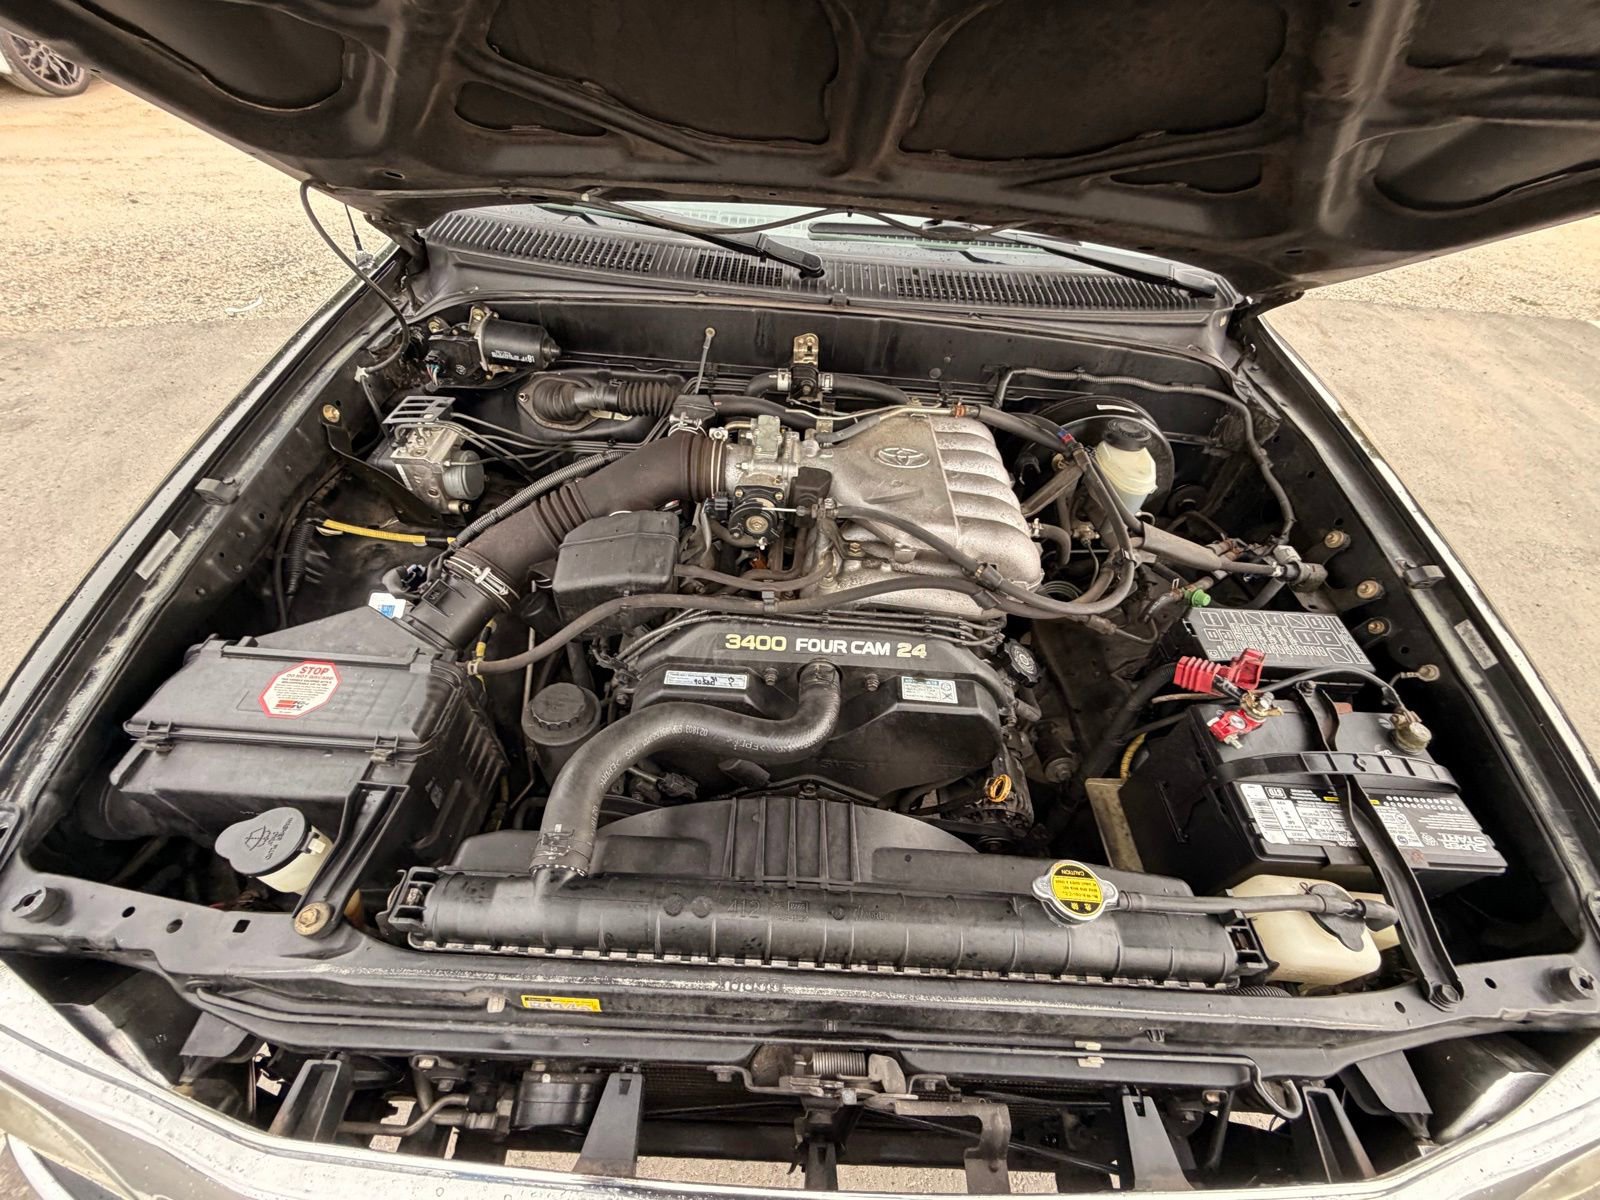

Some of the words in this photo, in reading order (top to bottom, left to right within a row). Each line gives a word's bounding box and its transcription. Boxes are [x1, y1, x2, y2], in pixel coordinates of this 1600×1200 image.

[725, 633, 787, 651] 3400
[795, 638, 848, 655] FOUR
[850, 641, 891, 656] CAM
[896, 642, 927, 659] 24
[299, 666, 330, 675] STOP
[1437, 832, 1487, 847] START
[1443, 841, 1487, 853] SUPER
[1060, 869, 1085, 877] CAUTION
[727, 899, 761, 919] 412
